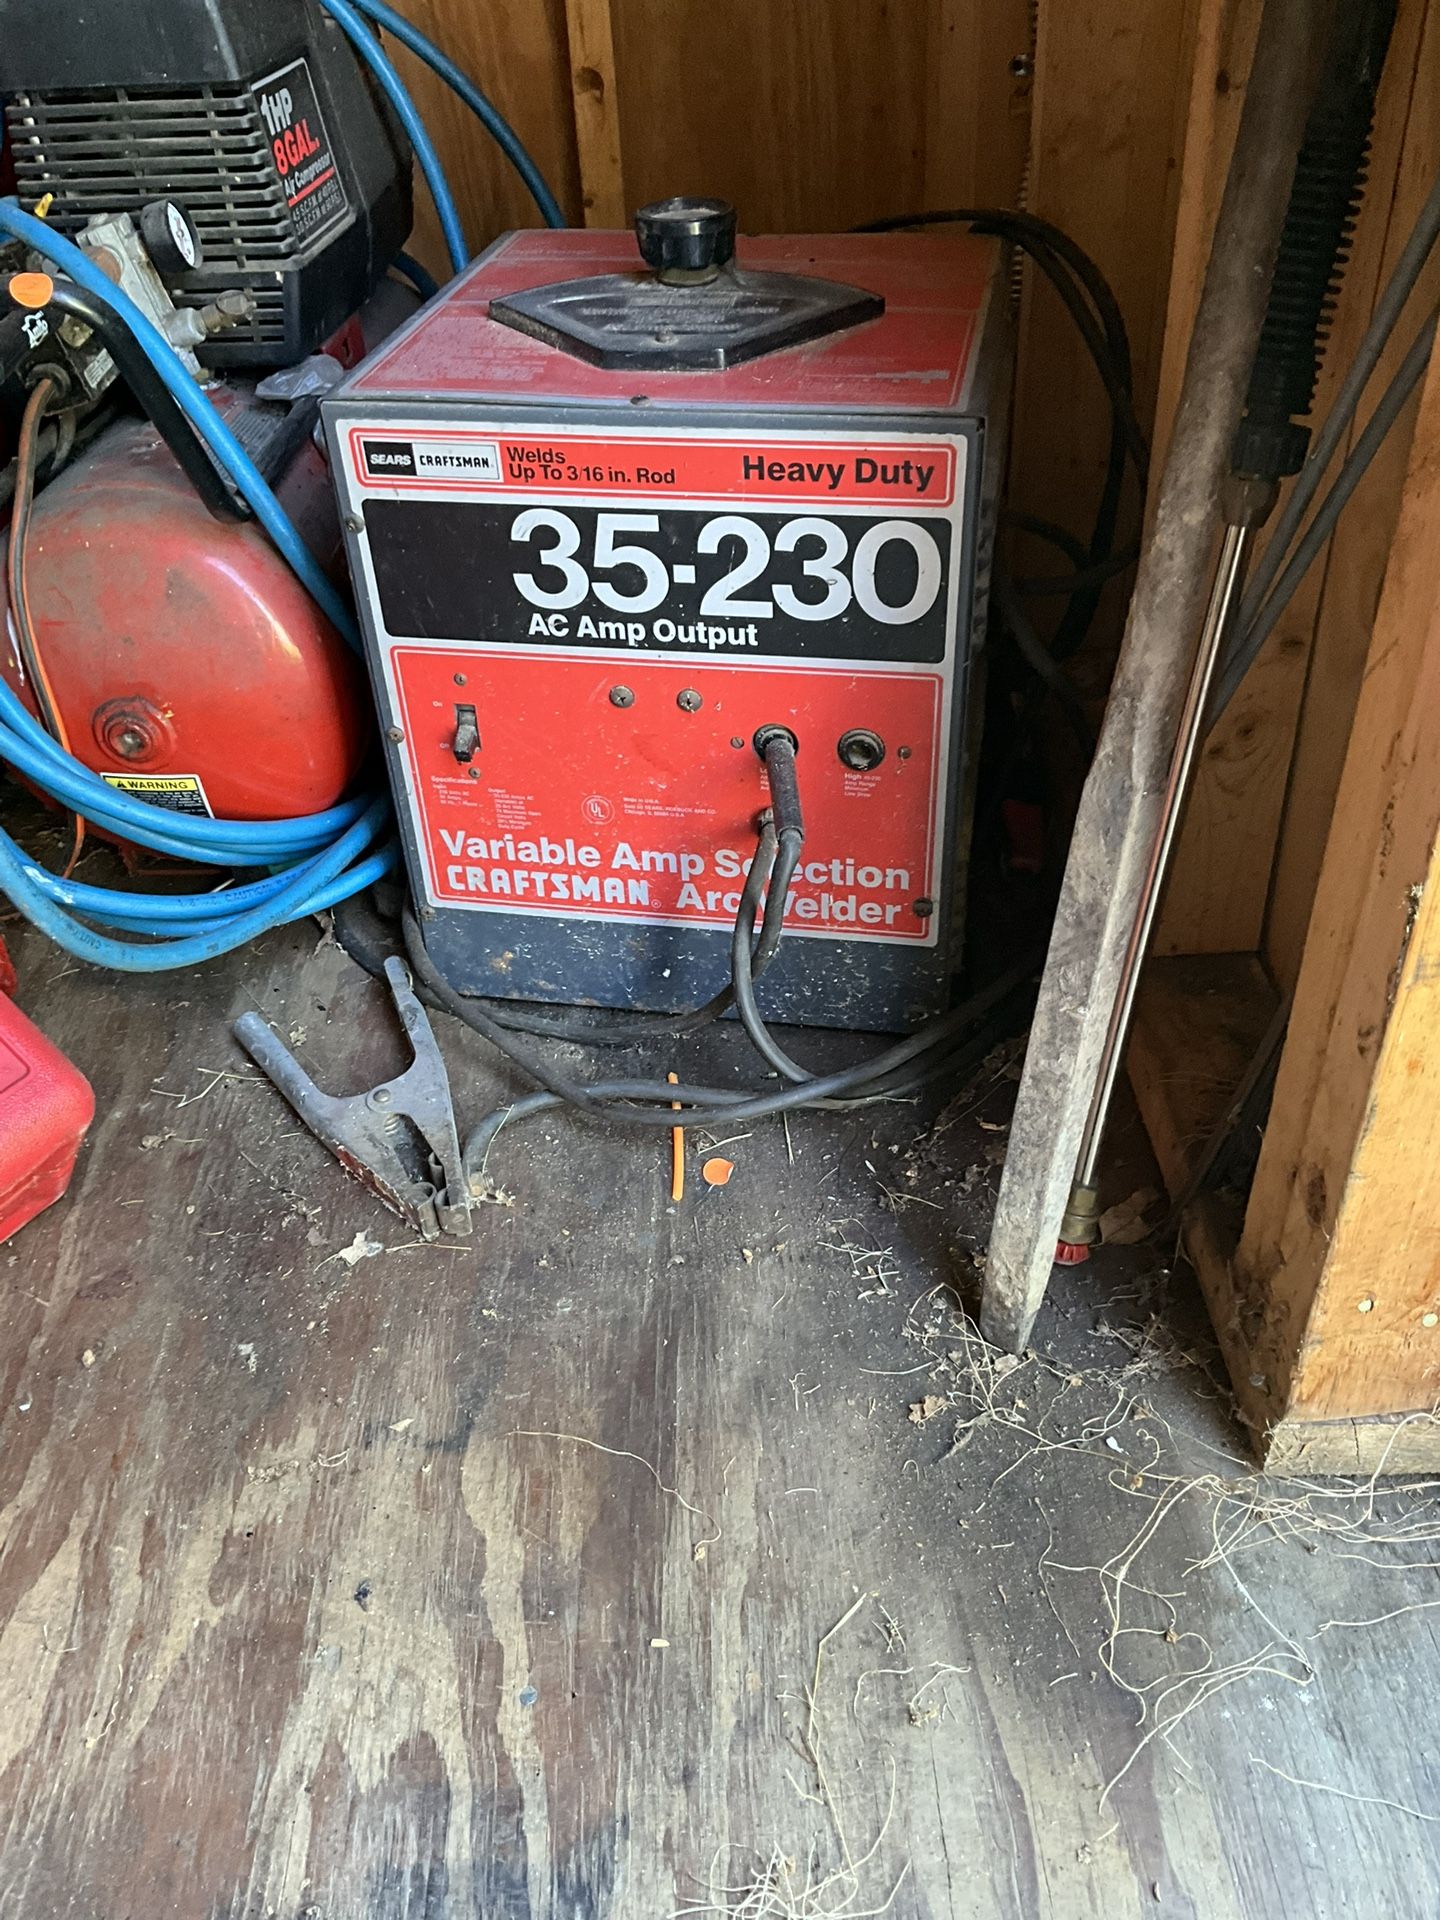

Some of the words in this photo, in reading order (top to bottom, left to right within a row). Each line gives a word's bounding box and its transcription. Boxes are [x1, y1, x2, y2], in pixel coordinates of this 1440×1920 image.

[295, 152, 331, 188] Compressor
[370, 453, 411, 467] SEARS
[419, 454, 490, 469] CRAFTSMAN
[506, 446, 566, 464] Welds
[509, 464, 535, 483] Up
[539, 465, 562, 481] To
[608, 466, 631, 483] in.
[636, 468, 675, 484] Rod
[743, 455, 845, 490] Heavy
[855, 458, 935, 492] Duty
[510, 508, 942, 625] 35-230
[528, 613, 570, 638] AC
[577, 615, 646, 648] Amp
[653, 619, 758, 650] Output
[126, 780, 188, 789] WARNING
[844, 772, 862, 781] High
[439, 828, 600, 867] Variable
[610, 842, 704, 880] Amp
[714, 849, 909, 890] Section
[446, 864, 650, 906] CRAFTSMAN
